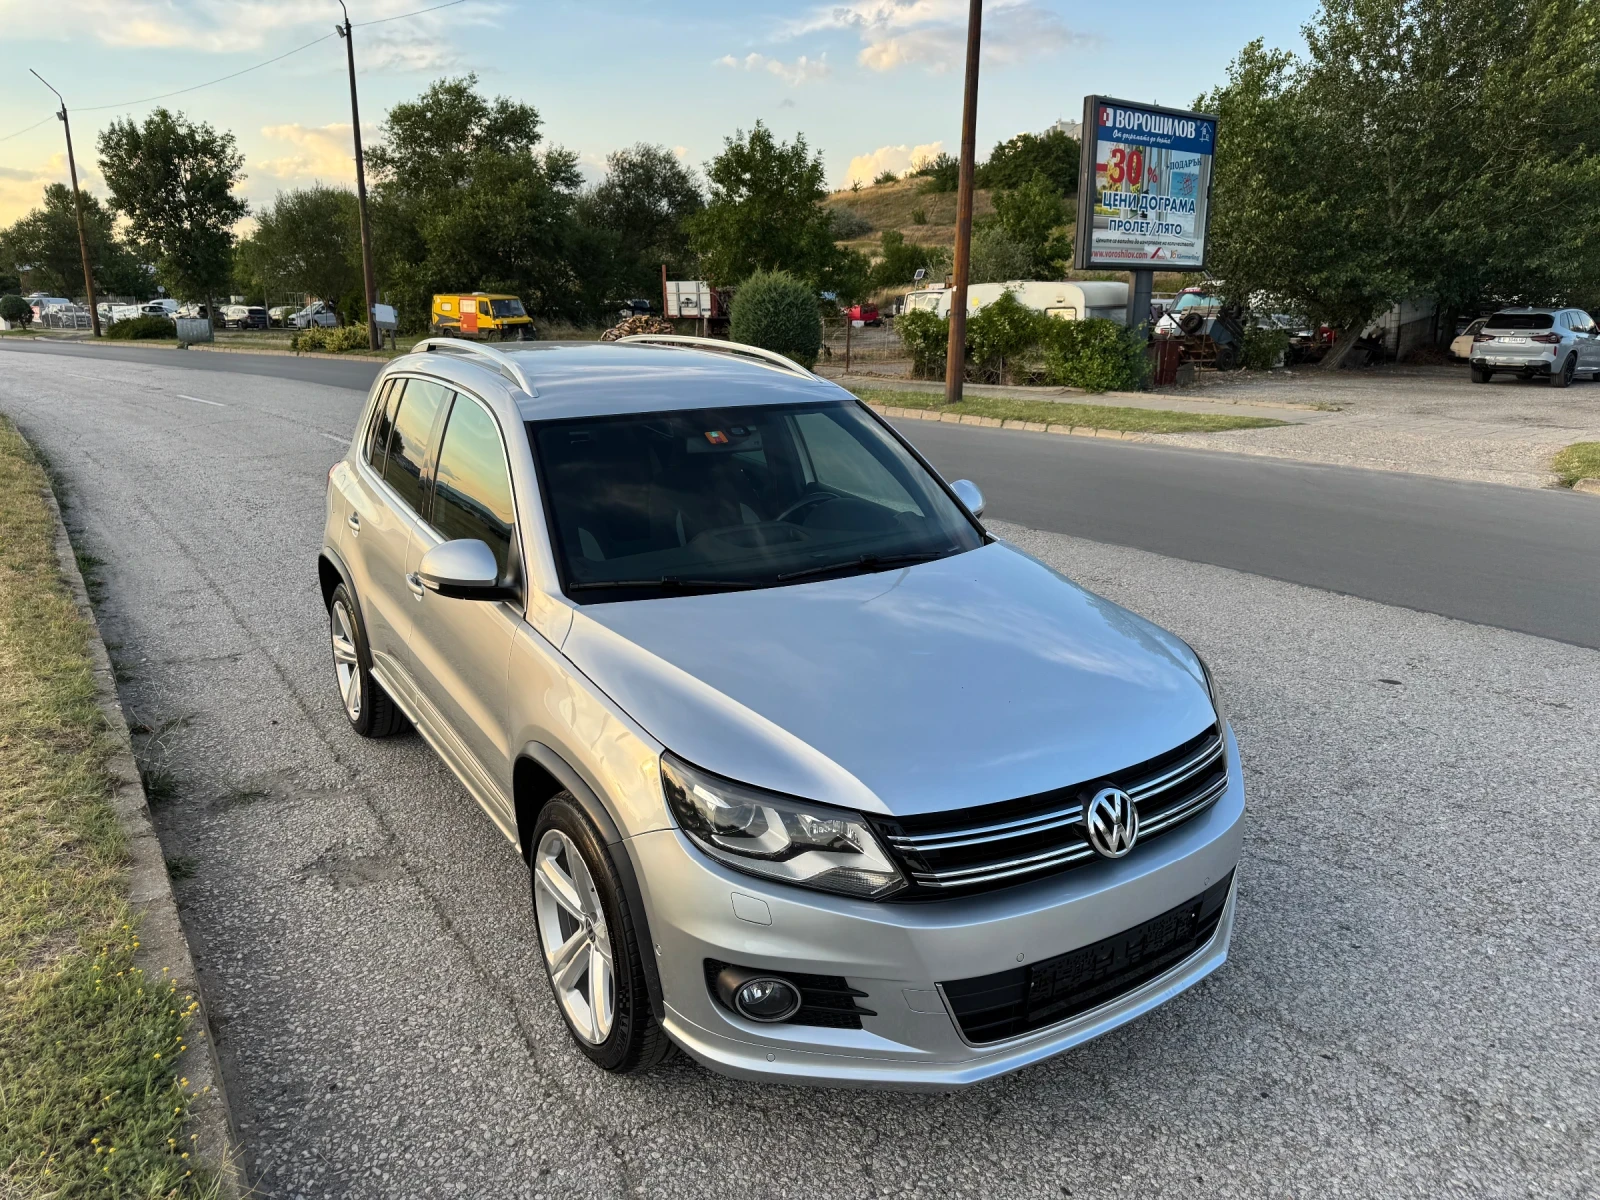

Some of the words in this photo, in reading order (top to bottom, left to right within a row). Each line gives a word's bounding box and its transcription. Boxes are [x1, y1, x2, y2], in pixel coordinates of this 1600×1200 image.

[1115, 109, 1196, 139] ВОРОШИЛОВ
[1102, 192, 1137, 210] ЦЕНИ
[1139, 196, 1196, 214] ДОГРАМА
